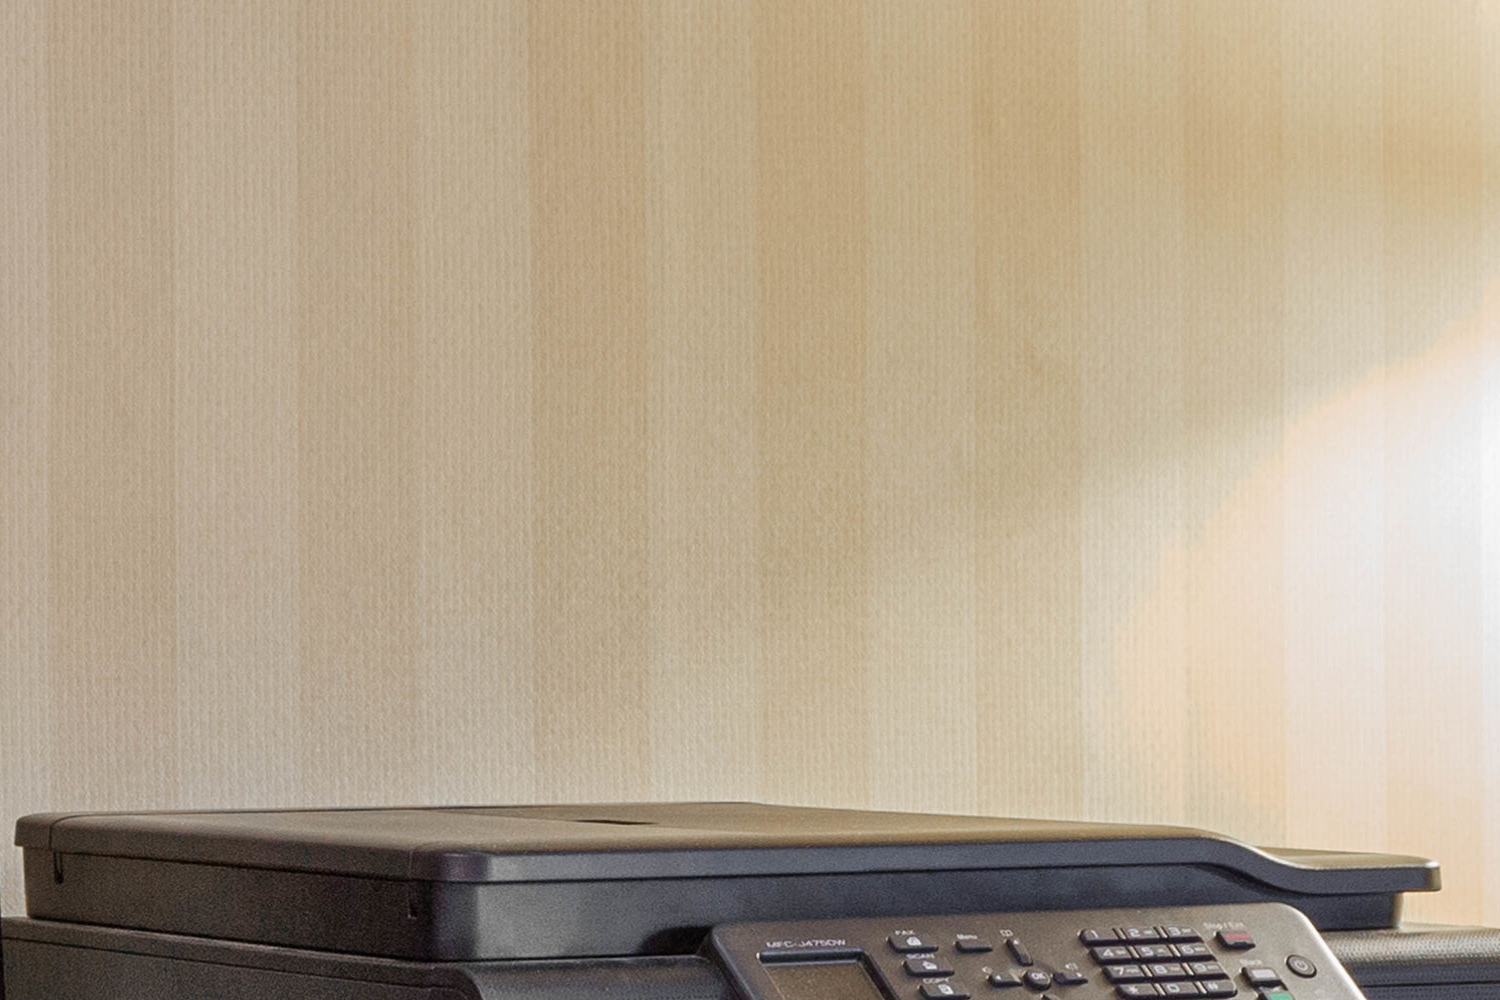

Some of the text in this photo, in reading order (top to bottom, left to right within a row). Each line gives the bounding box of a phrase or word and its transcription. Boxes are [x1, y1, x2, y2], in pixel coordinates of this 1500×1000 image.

[1090, 929, 1099, 939] 1
[1128, 928, 1140, 937] 2
[1168, 927, 1181, 936] 3
[1102, 948, 1114, 957] 4
[1141, 947, 1154, 956] 5
[1181, 945, 1194, 954] 6
[906, 952, 935, 960] SCAN
[1113, 966, 1125, 976] 7
[1154, 965, 1167, 974] 8
[1194, 963, 1208, 972] 9
[1166, 984, 1180, 992] 0
